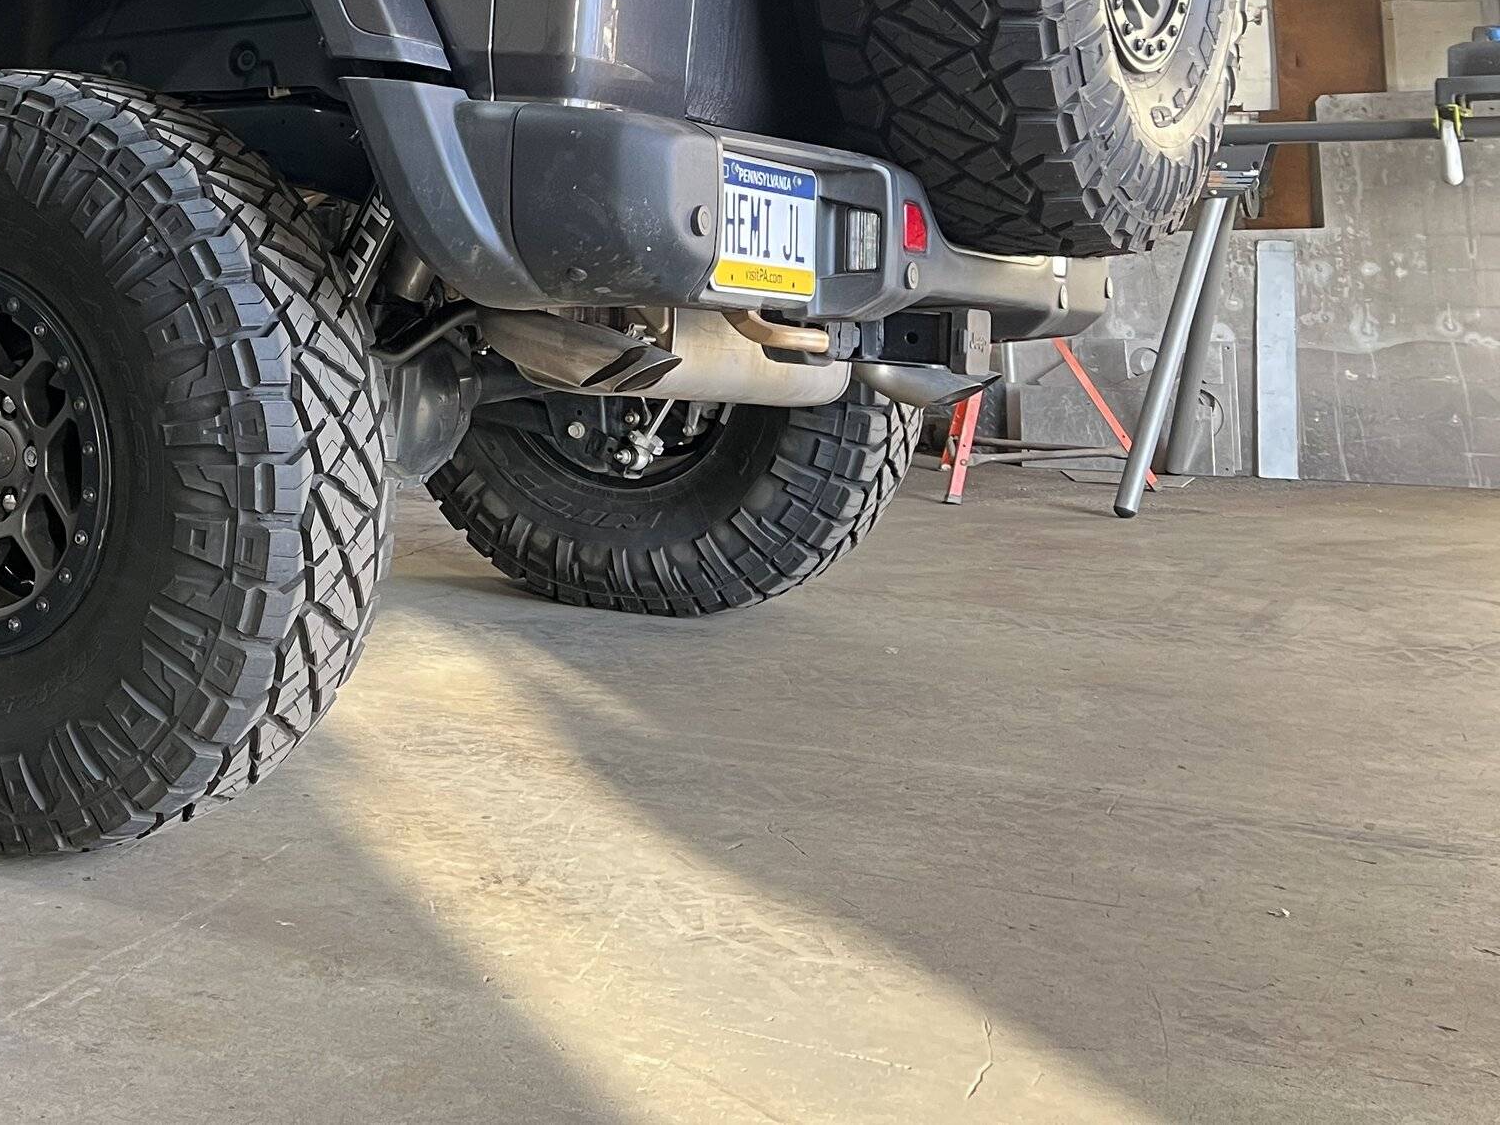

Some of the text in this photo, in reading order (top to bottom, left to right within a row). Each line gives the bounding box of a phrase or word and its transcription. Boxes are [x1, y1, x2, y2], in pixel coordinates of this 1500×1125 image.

[738, 166, 792, 191] PENNSYLVANIA
[725, 191, 805, 264] HEMI JL
[745, 267, 783, 284] visitPA.com
